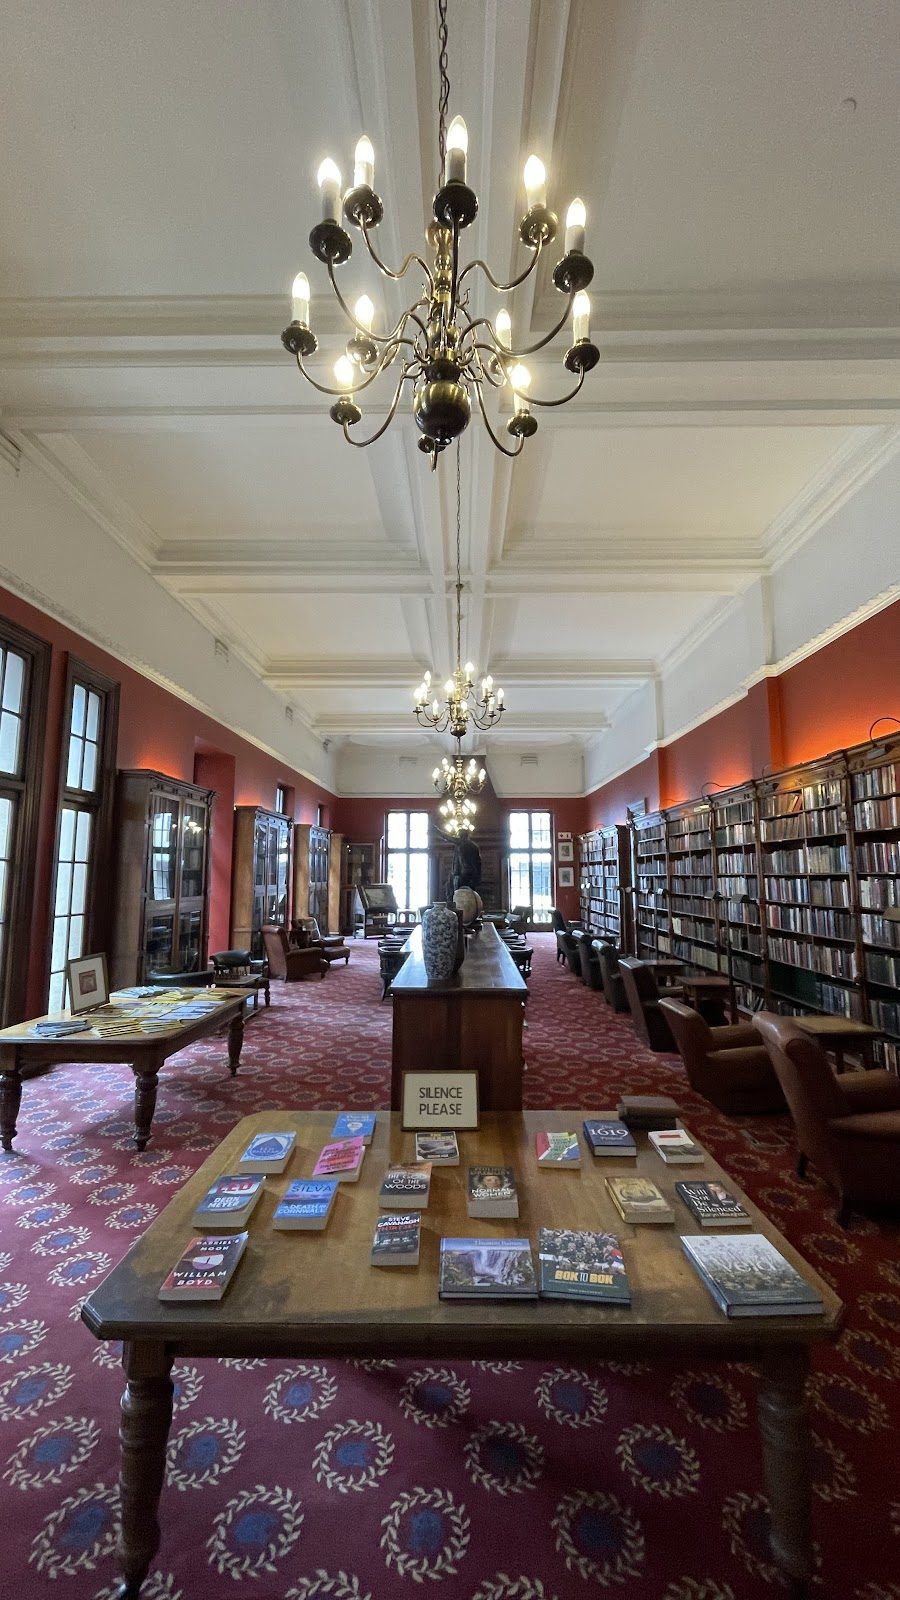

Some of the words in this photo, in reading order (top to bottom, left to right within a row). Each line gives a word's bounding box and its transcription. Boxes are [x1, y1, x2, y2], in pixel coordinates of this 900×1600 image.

[419, 1087, 463, 1098] SILENCE
[419, 1103, 462, 1115] PLEASE
[591, 1128, 628, 1137] 1619
[292, 1183, 332, 1193] SILVA
[173, 1270, 227, 1278] WILLIAM
[554, 1270, 579, 1282] BOK
[589, 1273, 614, 1285] BOK
